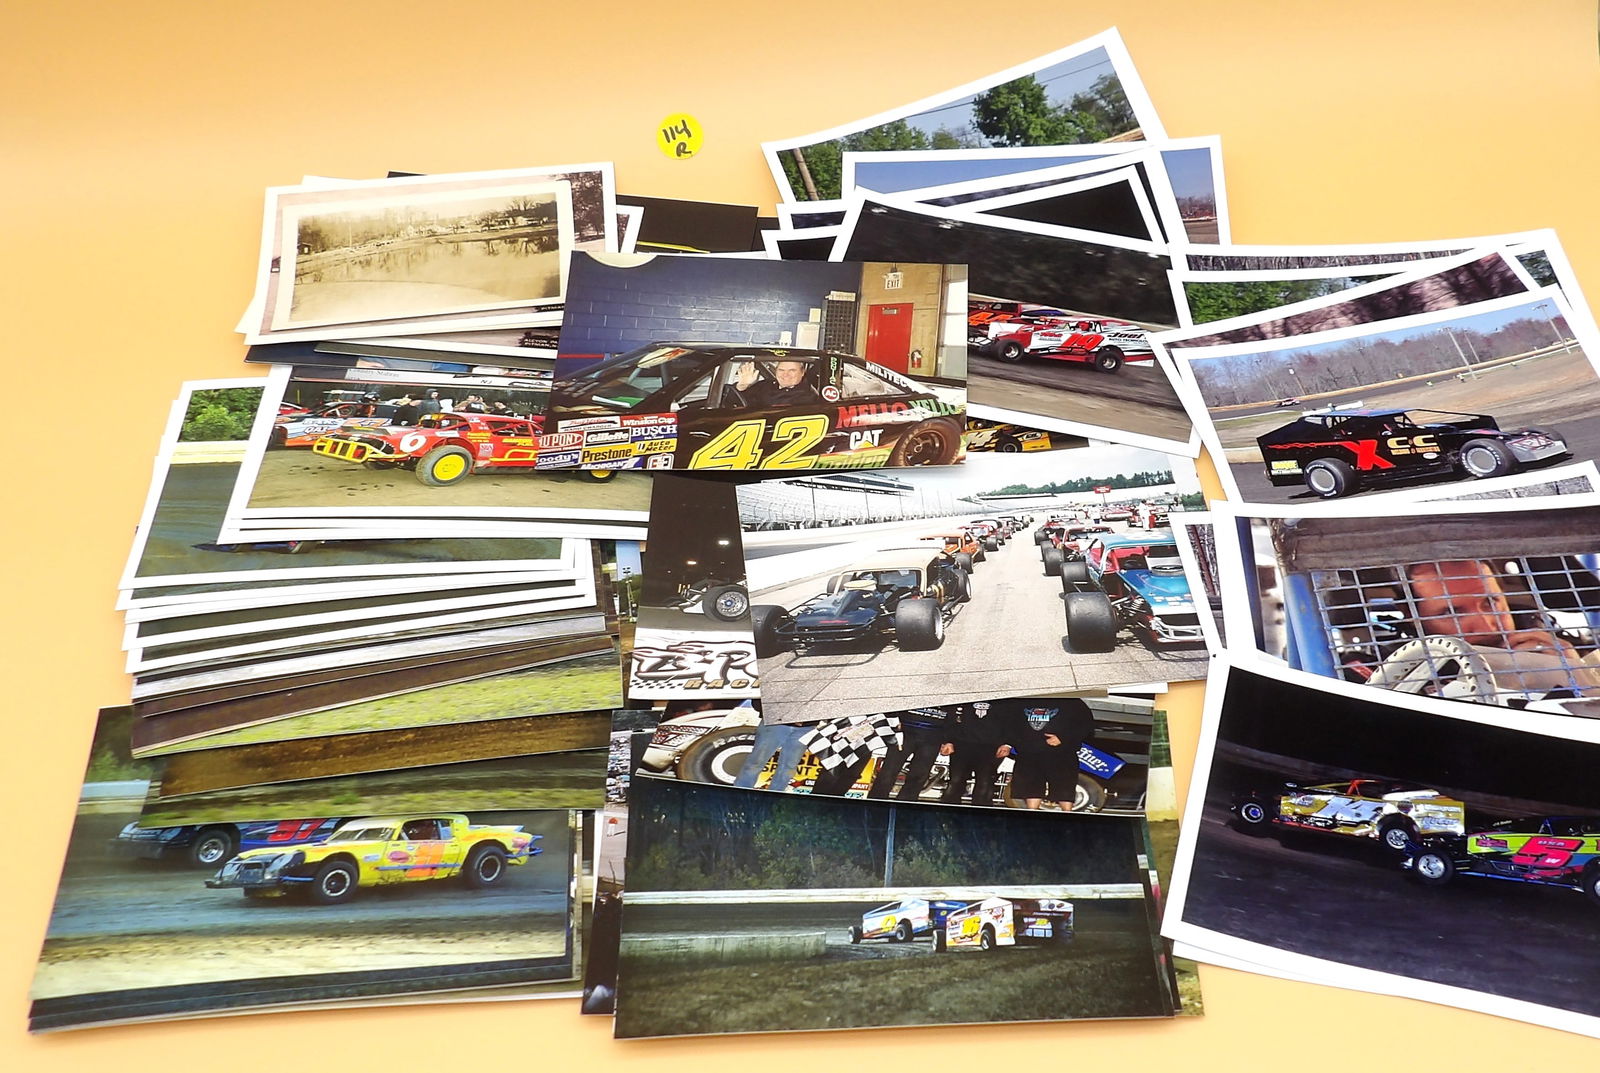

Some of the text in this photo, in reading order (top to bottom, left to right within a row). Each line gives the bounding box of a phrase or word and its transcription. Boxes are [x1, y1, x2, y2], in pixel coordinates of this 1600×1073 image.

[662, 119, 692, 143] 114
[676, 142, 692, 157] R
[886, 280, 900, 289] EXIT
[1061, 333, 1105, 351] 10
[824, 390, 838, 398] AC
[623, 416, 677, 427] Winston Cup
[836, 402, 908, 428] MELLO
[586, 430, 629, 443] Gillette
[631, 424, 678, 437] BUSCH
[400, 431, 427, 453] 6
[687, 414, 830, 470] 42
[849, 428, 884, 450] CAT
[581, 447, 632, 463] Prestone
